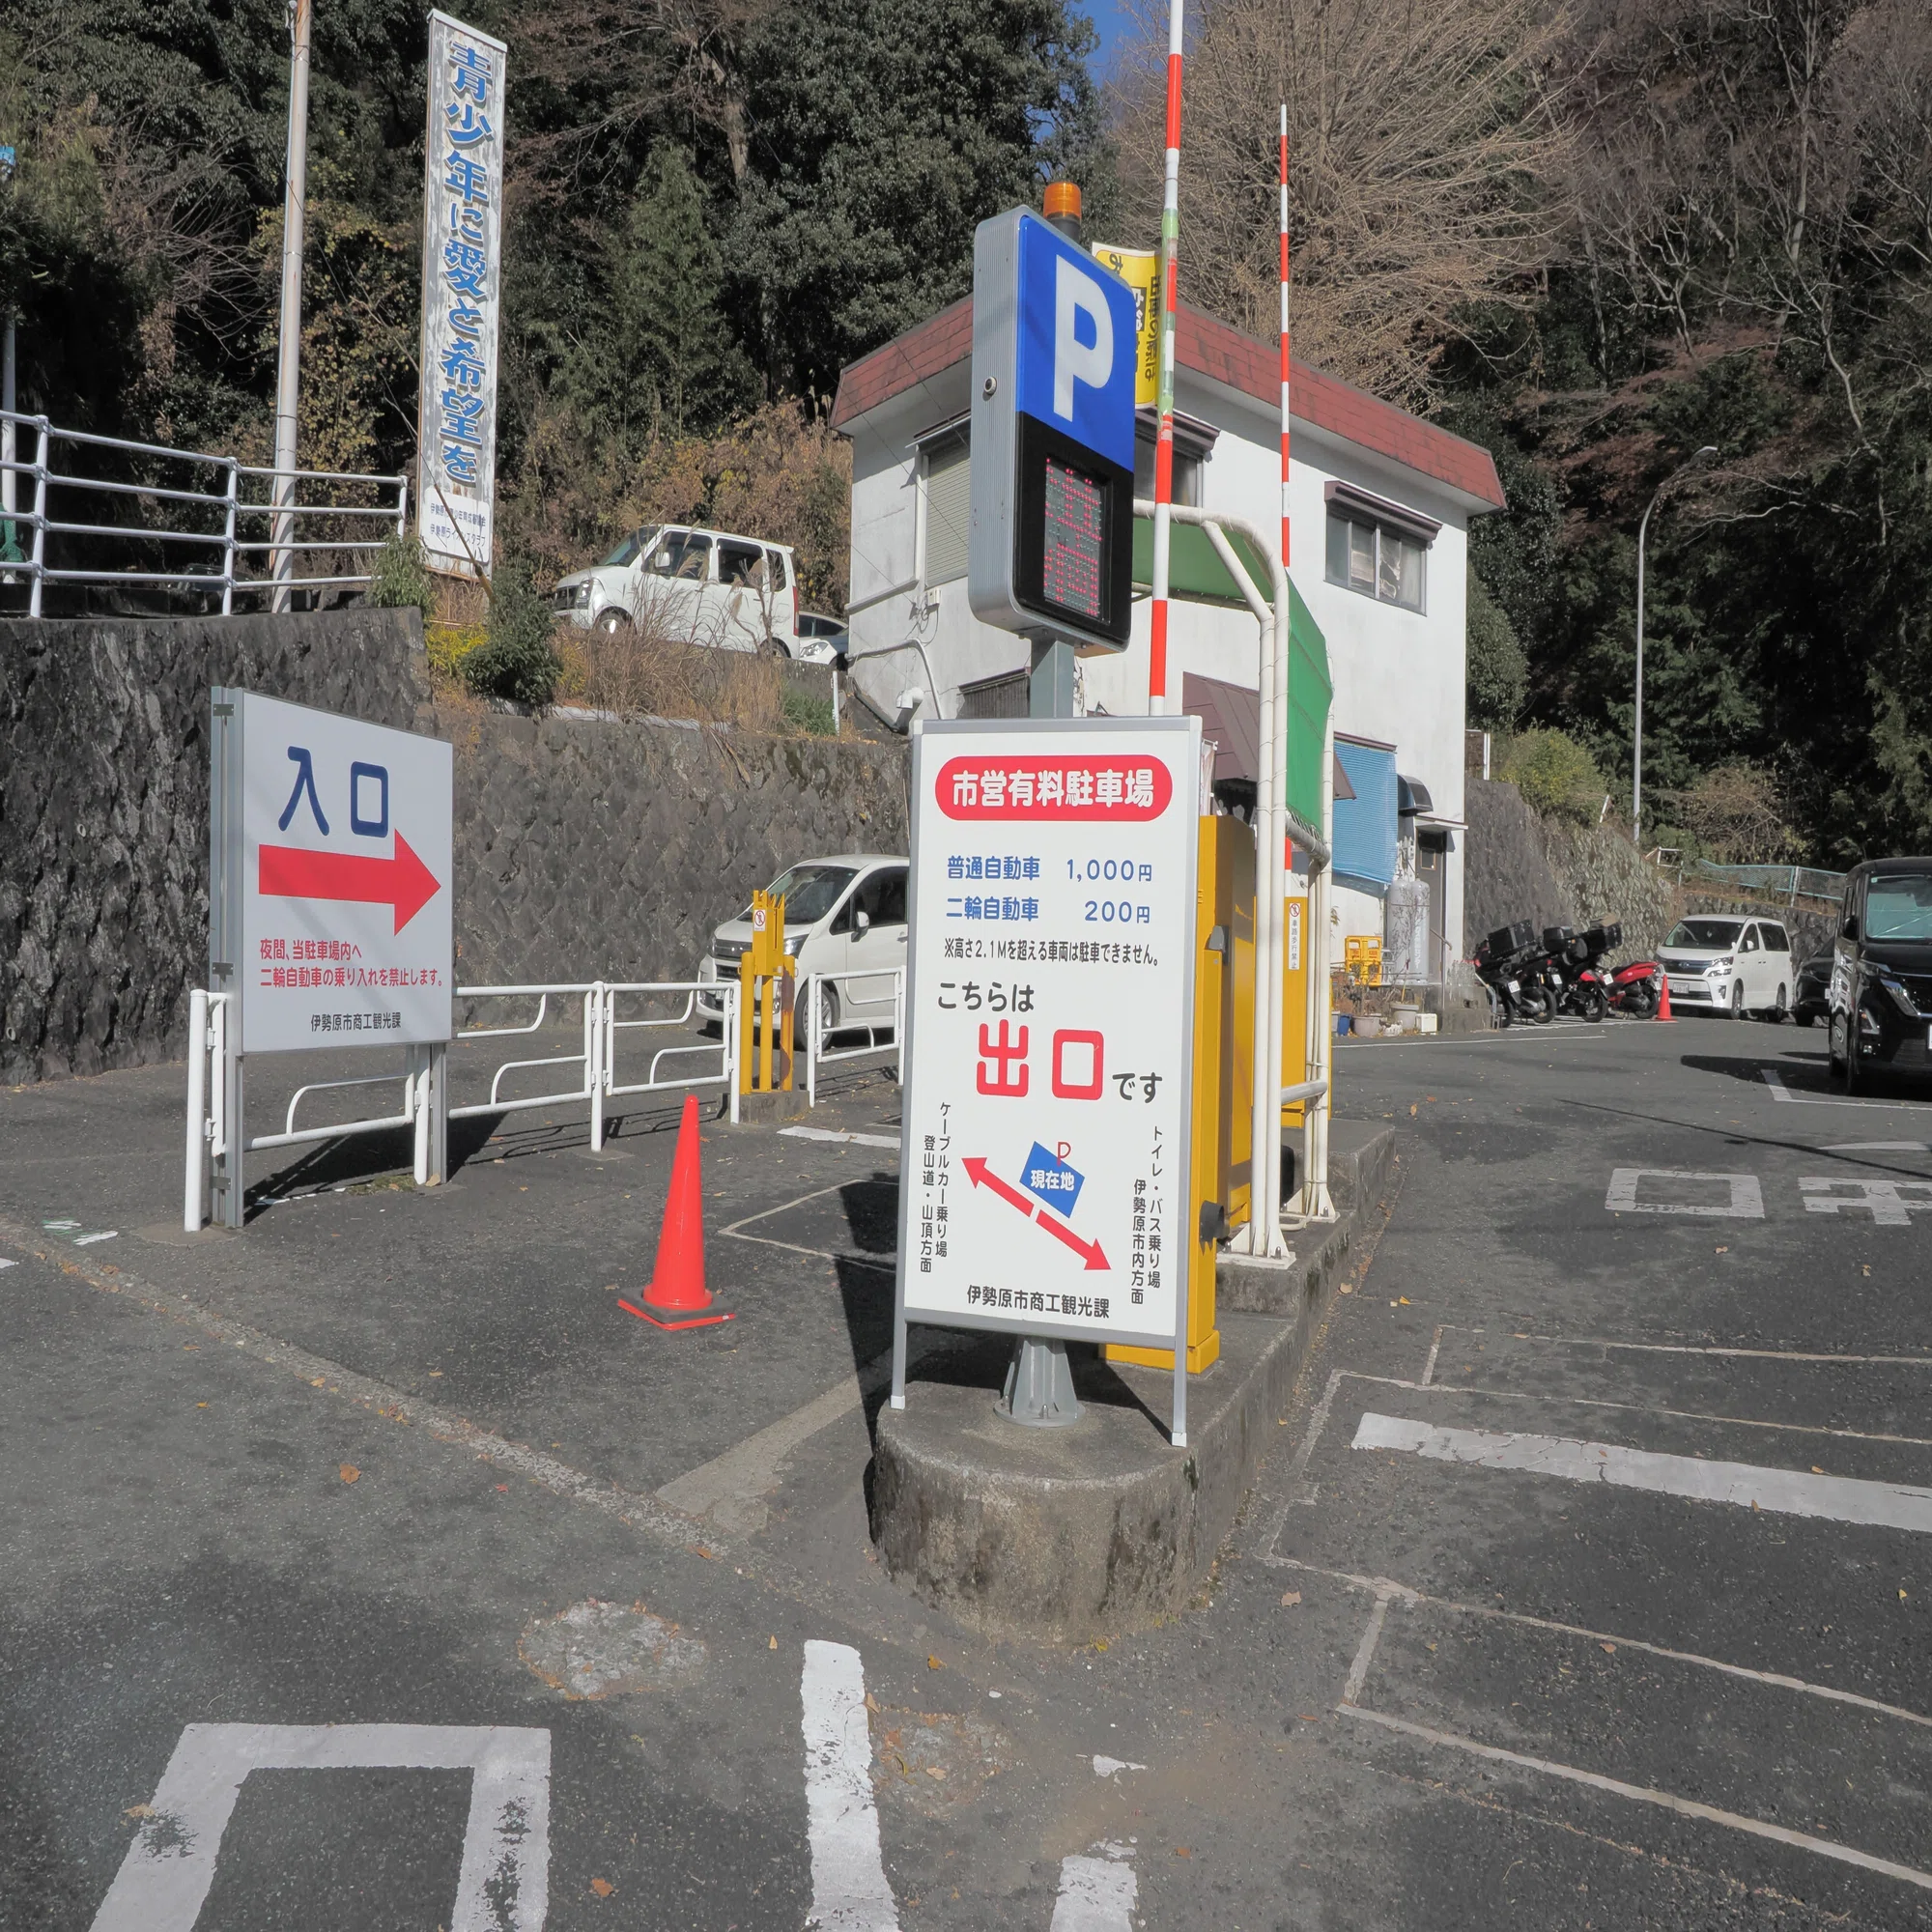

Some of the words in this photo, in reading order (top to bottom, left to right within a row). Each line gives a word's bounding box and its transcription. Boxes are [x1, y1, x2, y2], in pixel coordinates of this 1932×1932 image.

[440, 41, 494, 483] 青少年に愛と希望を
[1053, 254, 1114, 422] P
[278, 746, 388, 838] 入口
[952, 769, 1154, 808] 市営有料駐車場
[947, 856, 1040, 881] 普通自動車
[1066, 859, 1152, 882] 1,000円
[946, 896, 1039, 922] 二輪自動車
[1084, 900, 1151, 923] 200円
[260, 938, 362, 962] 夜間、当駐車場内へ
[260, 966, 443, 988] 二輪自動車の乗り入れを禁止します。
[938, 980, 1035, 1012] こちらは
[310, 1011, 402, 1033] 伊勢原市商工観光課
[976, 1019, 1104, 1100] 出口
[1112, 1072, 1163, 1104] です
[935, 1101, 952, 1258] ケーブルカー乗り場
[1030, 1169, 1075, 1192] 現在地
[920, 1135, 936, 1273] 登山道・山頂方面
[1147, 1125, 1163, 1289] トイレ・バス乗り場
[1130, 1179, 1147, 1305] 伊勢原市内方面
[967, 1284, 1110, 1319] 伊勢原市商工観光課
